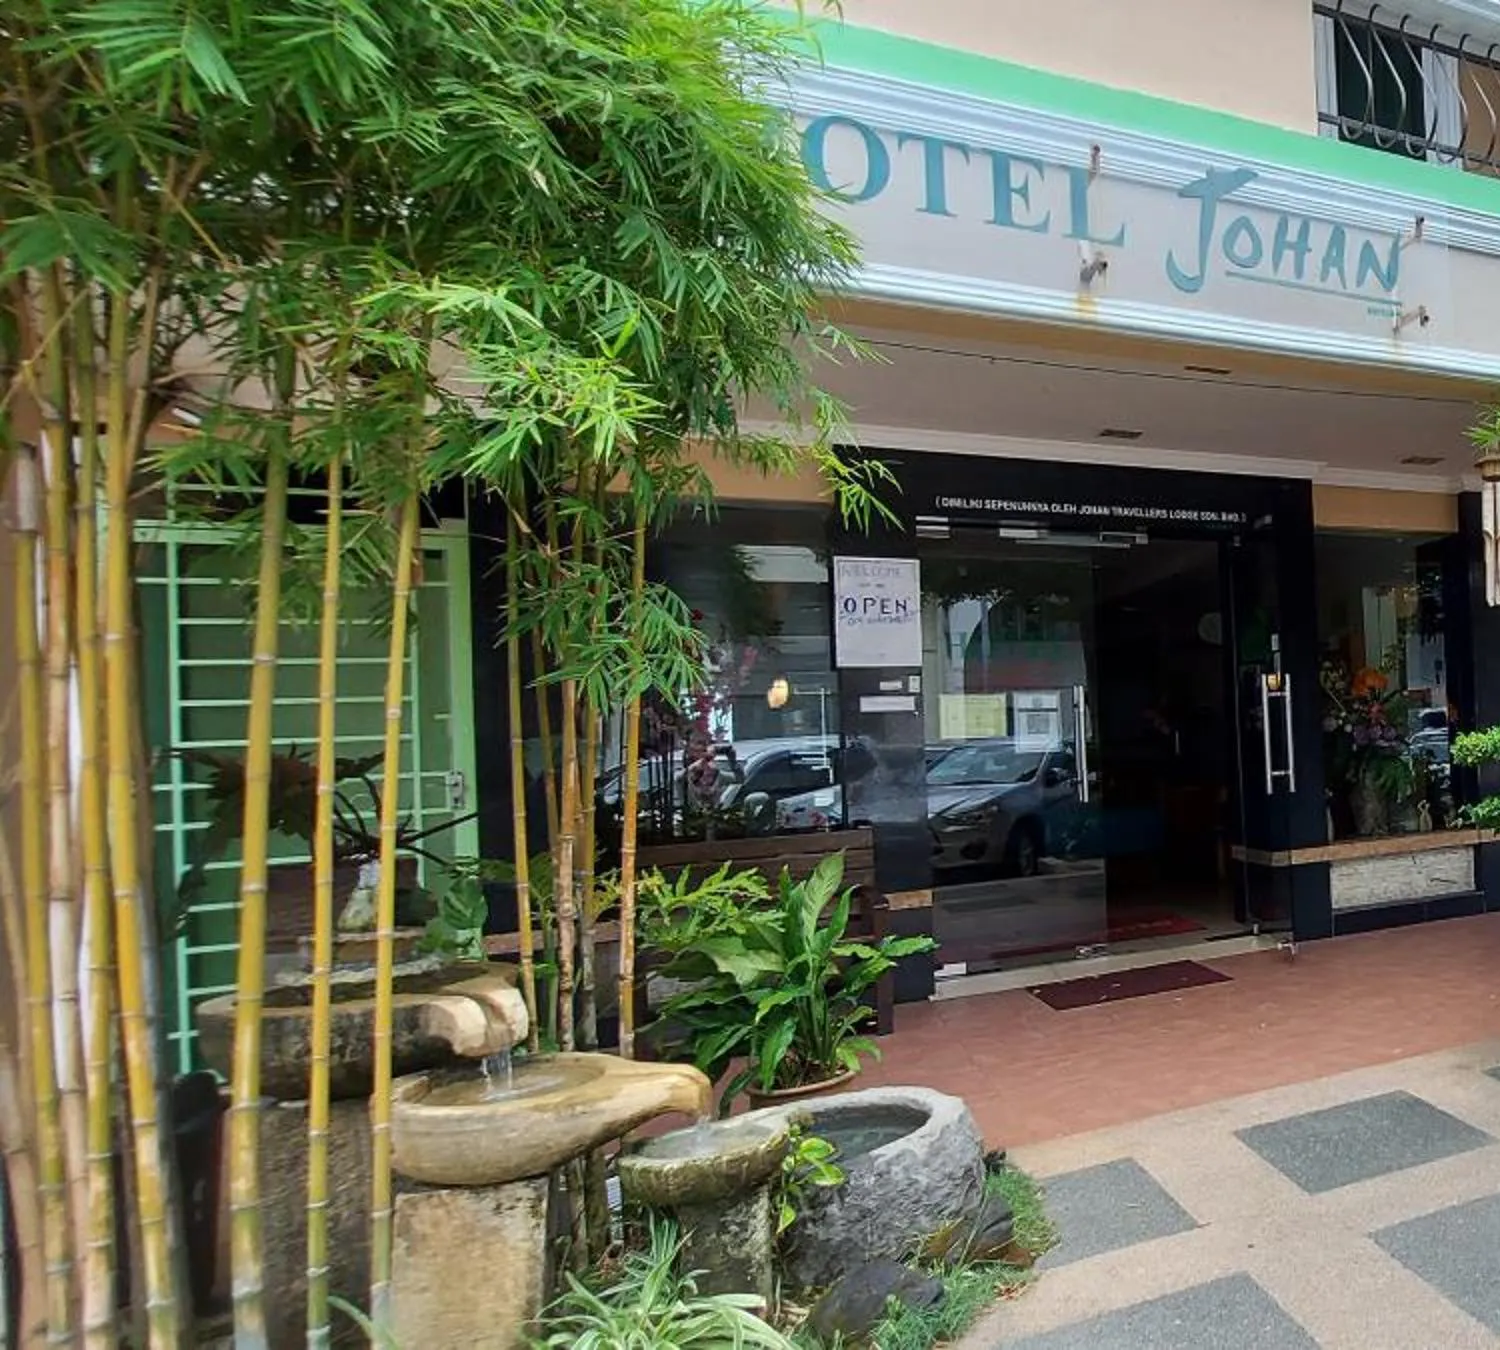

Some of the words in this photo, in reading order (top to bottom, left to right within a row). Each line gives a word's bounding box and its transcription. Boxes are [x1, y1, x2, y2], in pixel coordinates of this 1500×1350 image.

[800, 114, 1125, 246] OTEL
[1165, 164, 1402, 293] JOHAN
[1051, 503, 1077, 514] OLEH
[1079, 505, 1110, 515] JOHAN
[1111, 506, 1168, 518] TRAVELLERS
[1169, 509, 1199, 520] LODGE
[843, 597, 908, 615] OPEN
